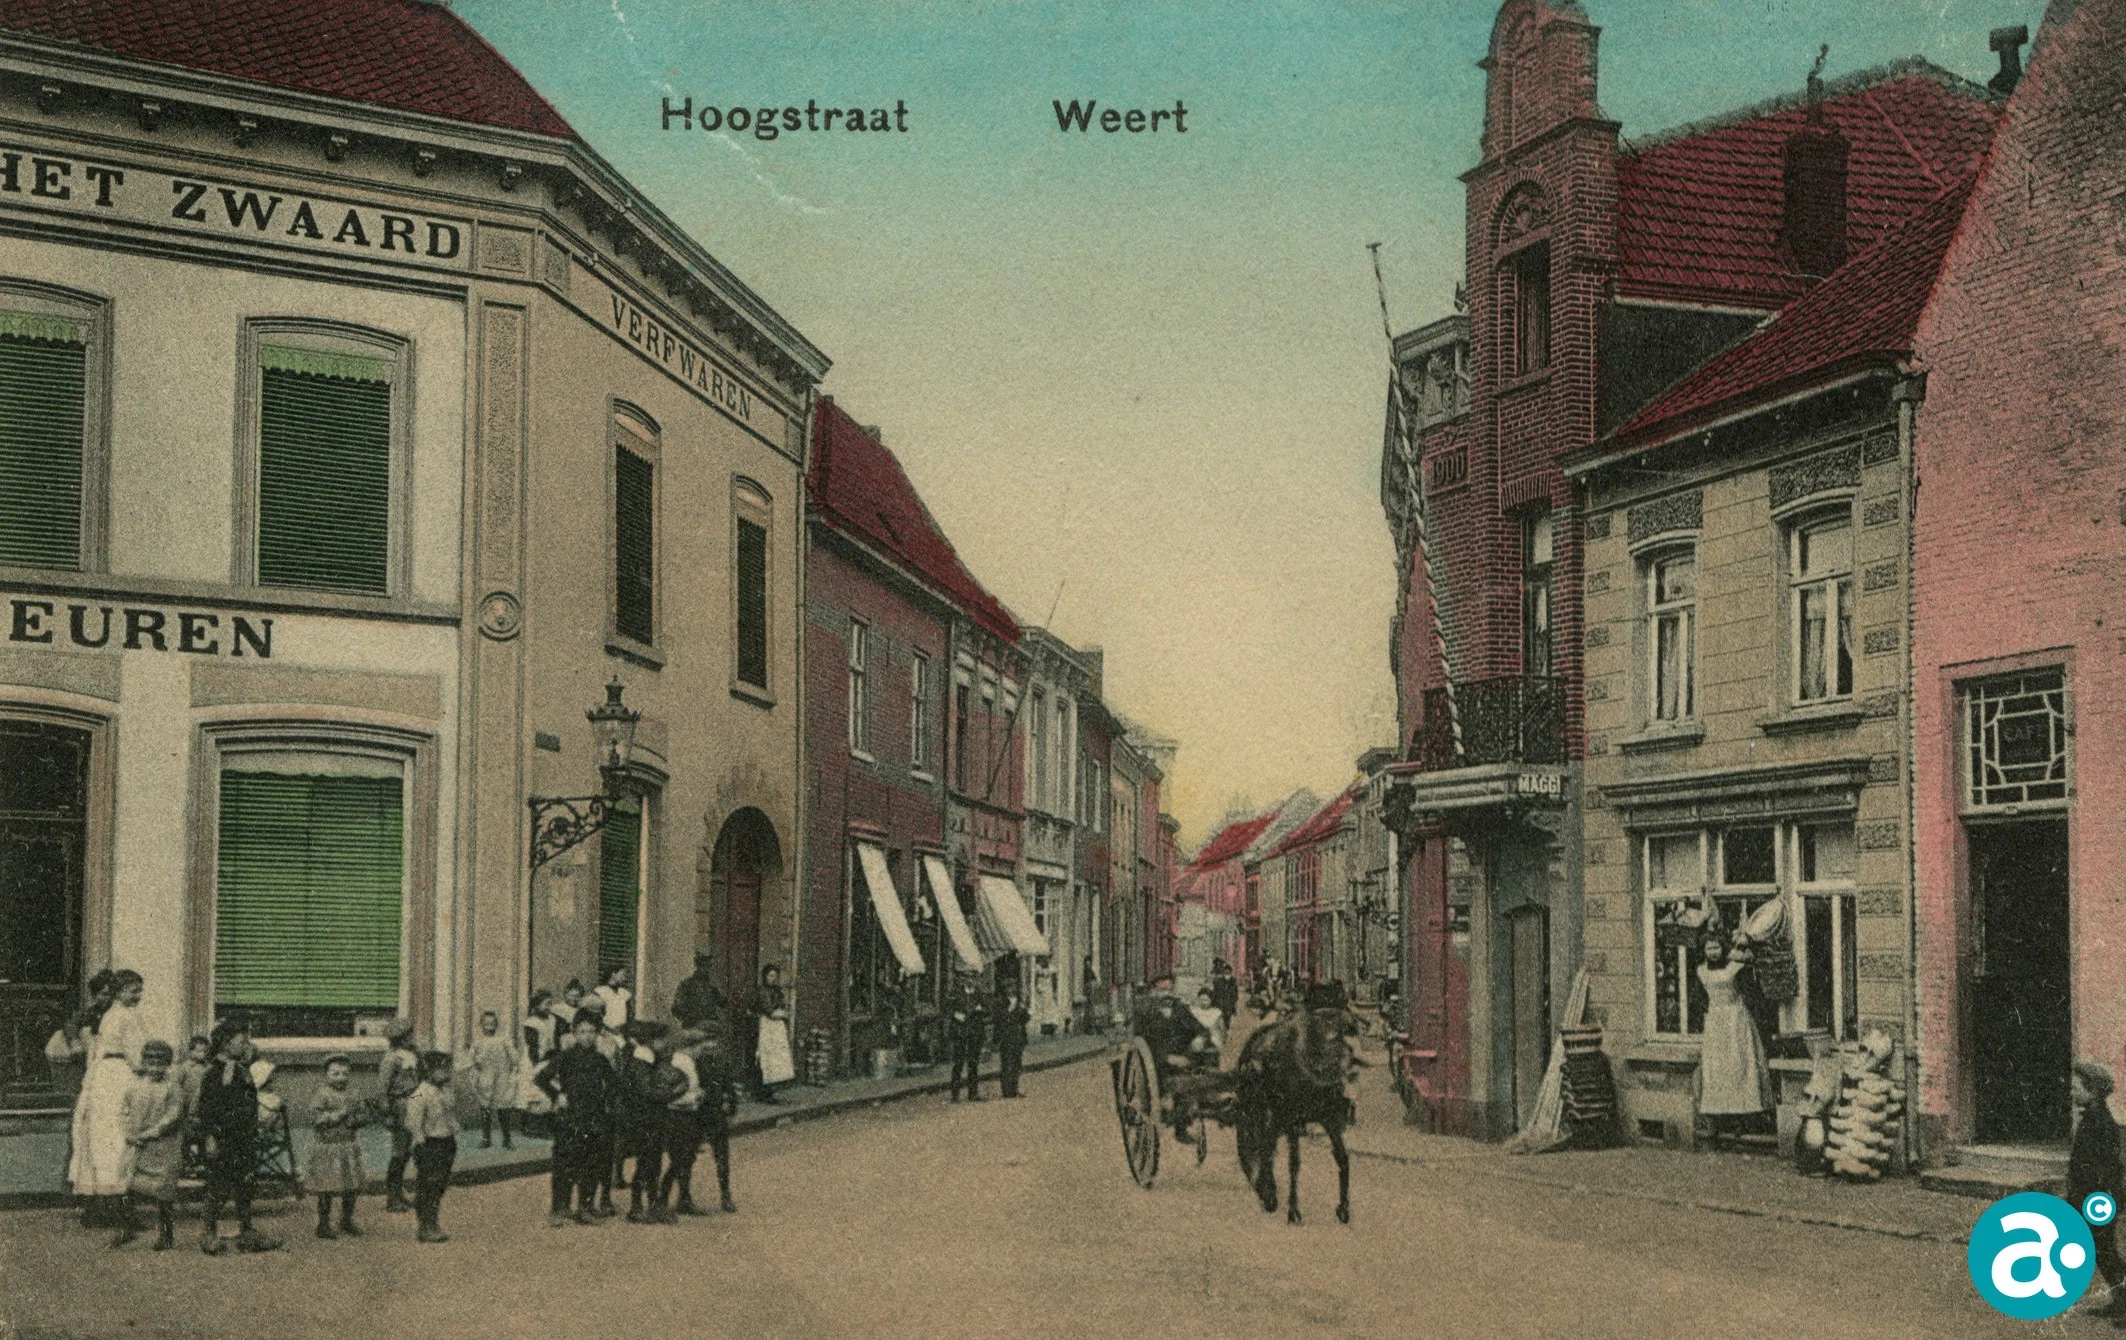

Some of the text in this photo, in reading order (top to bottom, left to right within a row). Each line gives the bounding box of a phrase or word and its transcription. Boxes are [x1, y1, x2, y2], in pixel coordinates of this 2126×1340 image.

[0, 152, 461, 260] HET ZWAARD
[611, 294, 752, 421] VERFWAREN
[9, 600, 273, 659] EUREN
[1518, 774, 1561, 793] MAGGI
